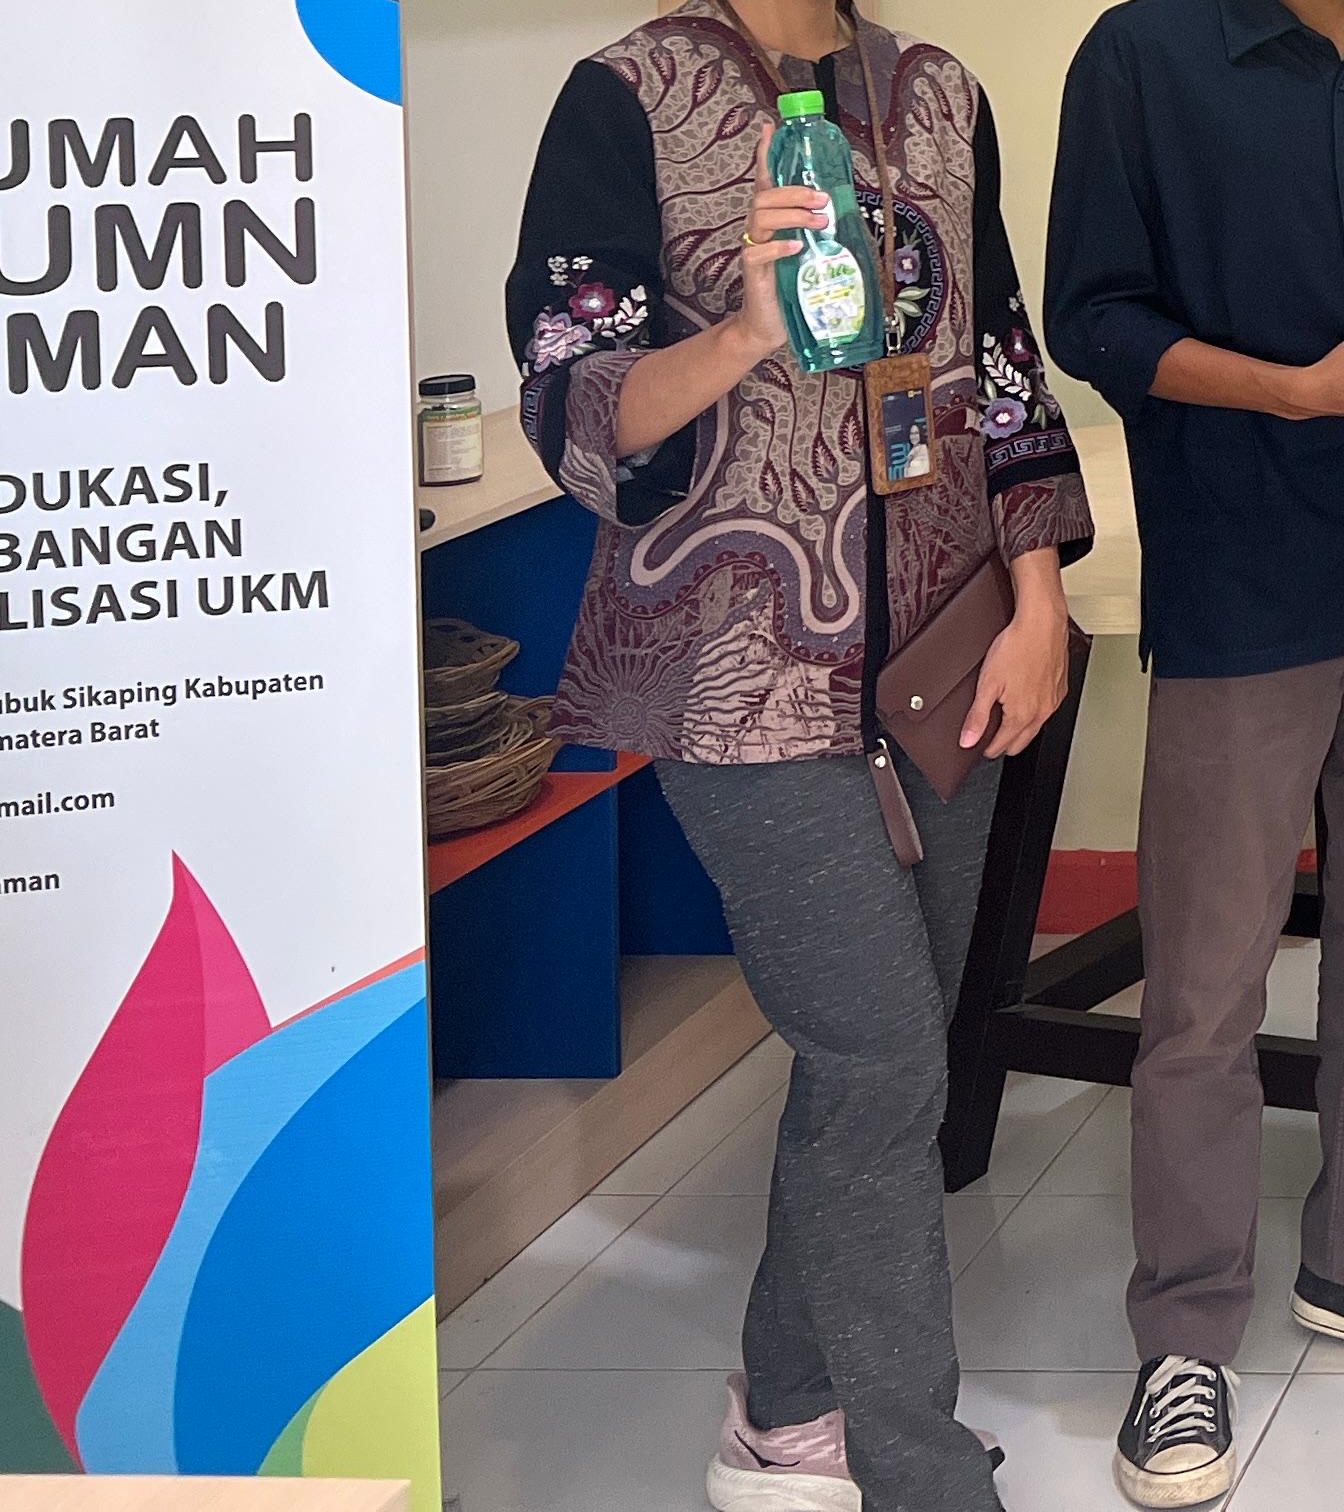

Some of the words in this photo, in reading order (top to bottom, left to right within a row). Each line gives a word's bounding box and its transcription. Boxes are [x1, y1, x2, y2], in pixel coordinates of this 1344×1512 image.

[7, 300, 287, 395] MAN
[0, 579, 179, 631] LISASI
[197, 569, 330, 616] UKM
[0, 689, 57, 715] buk
[62, 682, 178, 710] Sikaping
[184, 672, 325, 701] Kabupaten
[90, 718, 160, 744] Barat
[0, 873, 60, 894] man
